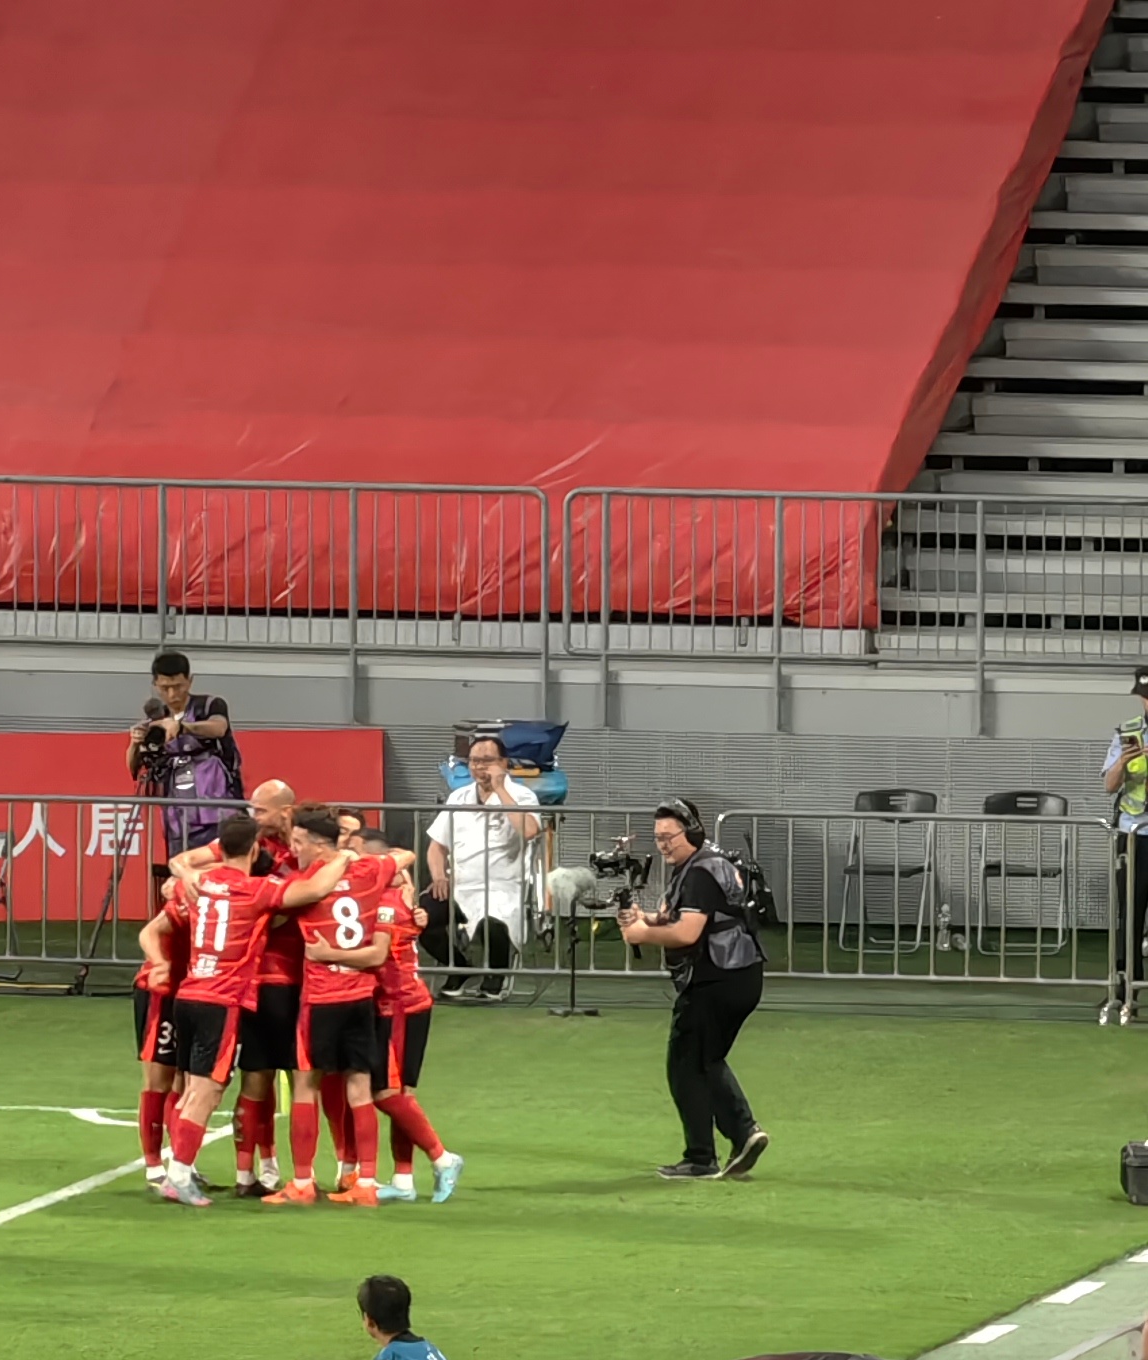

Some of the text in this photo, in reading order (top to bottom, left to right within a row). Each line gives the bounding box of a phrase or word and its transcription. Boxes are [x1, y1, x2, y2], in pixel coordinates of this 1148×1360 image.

[194, 896, 230, 952] 11
[332, 896, 364, 949] 8
[158, 1021, 178, 1049] 3
